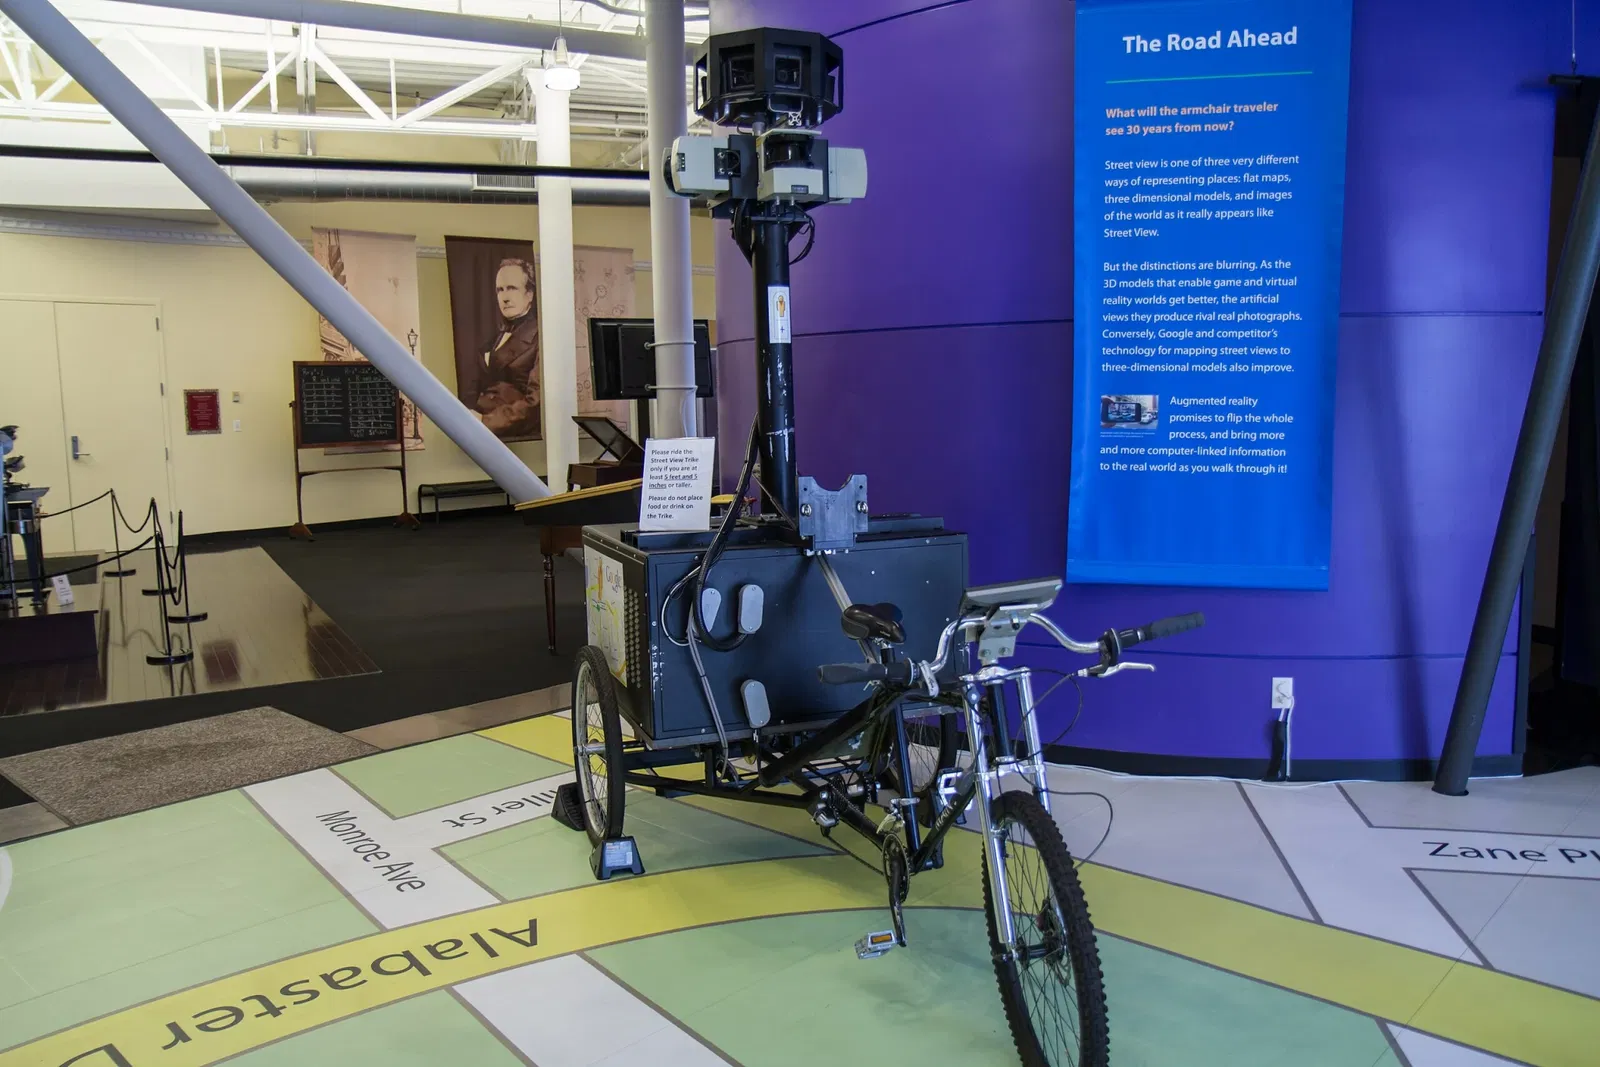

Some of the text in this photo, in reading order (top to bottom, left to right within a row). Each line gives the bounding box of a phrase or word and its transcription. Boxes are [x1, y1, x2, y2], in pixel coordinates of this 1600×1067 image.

[1122, 26, 1297, 53] The Road Ahead
[1106, 101, 1278, 118] What will the armchair traveler
[1105, 121, 1234, 136] see 30 years from now?
[1105, 154, 1299, 170] Street view is one of three very different
[1105, 173, 1291, 188] ways of representing places: flat maps,
[1104, 190, 1292, 204] three dimensional models, and images
[1104, 211, 1114, 221] of
[1116, 211, 1132, 220] the
[1134, 210, 1162, 220] world
[1177, 209, 1184, 219] it
[1186, 209, 1213, 220] really
[1214, 210, 1254, 220] appears
[1256, 207, 1274, 217] like
[1104, 228, 1159, 238] Street View.
[1103, 260, 1291, 271] But the distinctions are blurring. As the
[1104, 277, 1297, 289] 3D models that enable game and virtual
[1103, 294, 1279, 307] reality worlds get better, the artificial
[1131, 312, 1152, 323] they
[1154, 312, 1194, 323] produce
[1195, 312, 1216, 321] rival
[1217, 311, 1235, 321] real
[1237, 311, 1302, 323] photographs.
[1102, 329, 1156, 340] Conversely,
[1158, 329, 1194, 340] Google
[1195, 329, 1214, 338] and
[1102, 345, 1291, 357] technology for mapping street views to
[1102, 362, 1294, 373] three-dimensional models also improve.
[1170, 396, 1258, 407] Augmented reality
[1169, 413, 1293, 424] promises to flip the whole
[1169, 430, 1285, 442] process, and bring more
[1100, 445, 1286, 457] and more computer-linked information
[1112, 462, 1128, 471] the
[1130, 462, 1147, 471] real
[1149, 463, 1177, 472] world
[1191, 465, 1209, 474] you
[1211, 463, 1234, 472] walk
[1236, 464, 1275, 475] through
[1278, 464, 1287, 473] it!
[442, 789, 556, 828] iller St
[316, 810, 425, 892] Monroe Ave
[1422, 841, 1547, 862] Zane
[161, 918, 538, 1050] Alabaster
